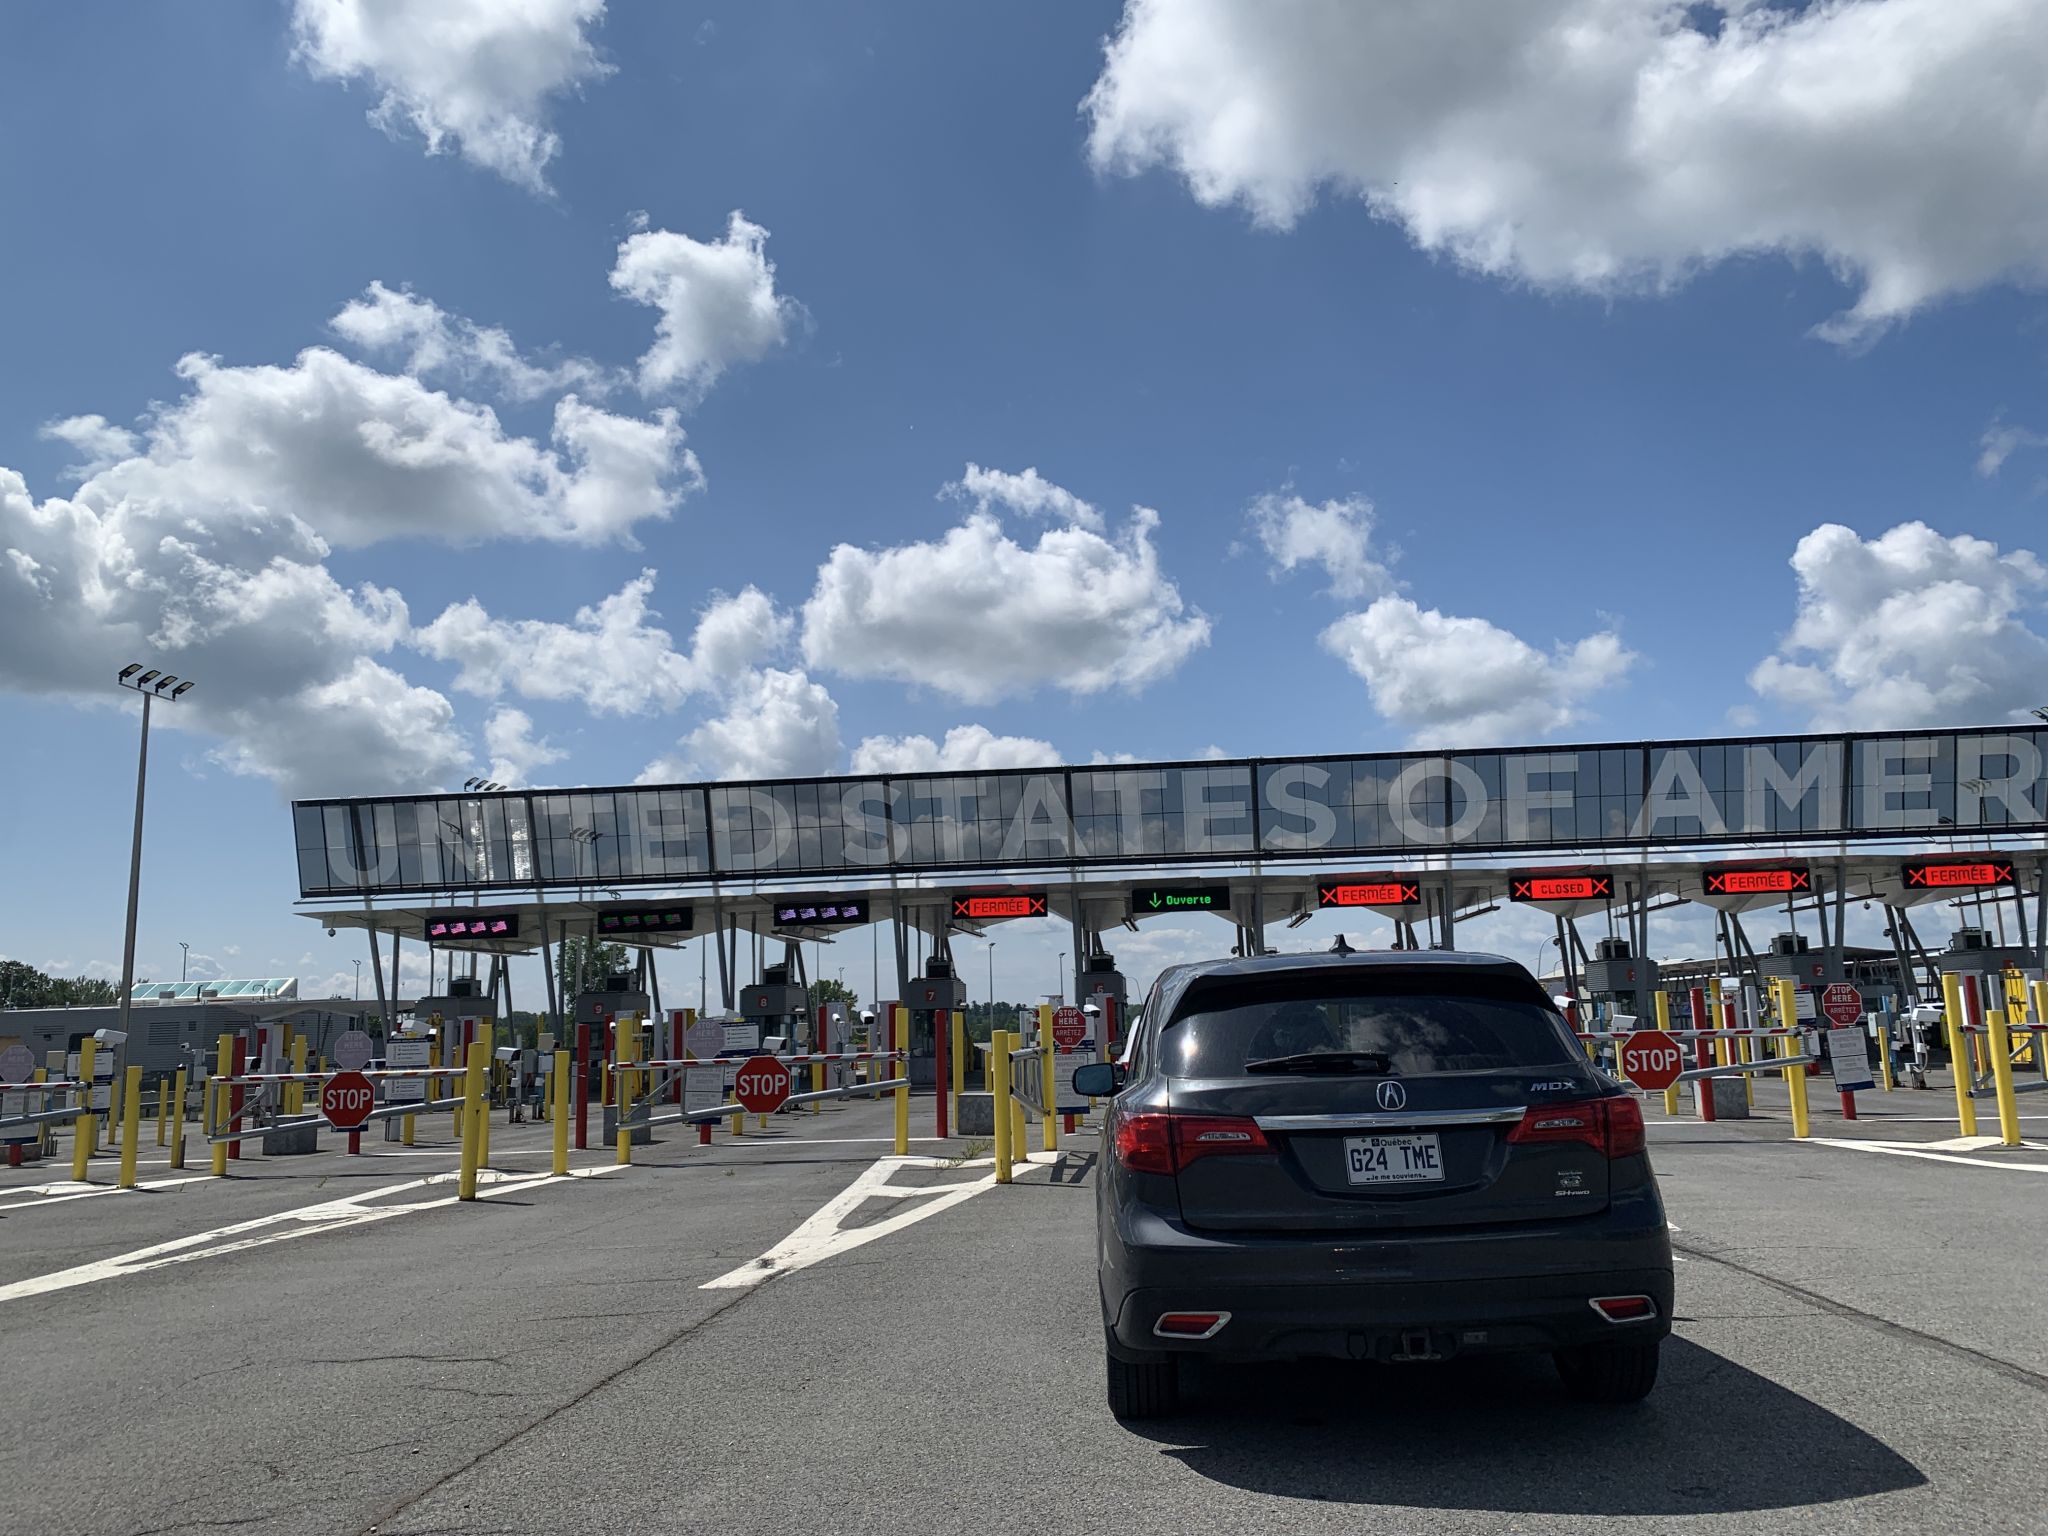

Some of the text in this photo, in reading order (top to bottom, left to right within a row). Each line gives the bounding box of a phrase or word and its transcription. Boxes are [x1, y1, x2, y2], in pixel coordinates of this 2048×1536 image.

[326, 736, 2048, 886] UNITED STATES OF AMER
[1931, 866, 1988, 881] FERMÉE
[1730, 873, 1785, 888] FERMÉE
[1342, 885, 1395, 901] FERMÉE
[1541, 883, 1584, 894] CLOSED
[973, 898, 1024, 913] FERMÉE
[1166, 895, 1212, 905] Ouverte
[1816, 966, 1825, 976] 2
[927, 991, 935, 1000] 7
[1831, 986, 1852, 994] STOP
[759, 998, 768, 1007] 8
[1831, 994, 1853, 1002] HERE
[1058, 1009, 1078, 1017] STOP
[1626, 1048, 1678, 1072] STOP
[738, 1074, 787, 1096] STOP
[1530, 1081, 1577, 1092] MDX
[325, 1088, 371, 1110] STOP
[1380, 1138, 1412, 1147] Québec
[1350, 1145, 1439, 1172] G24 TME
